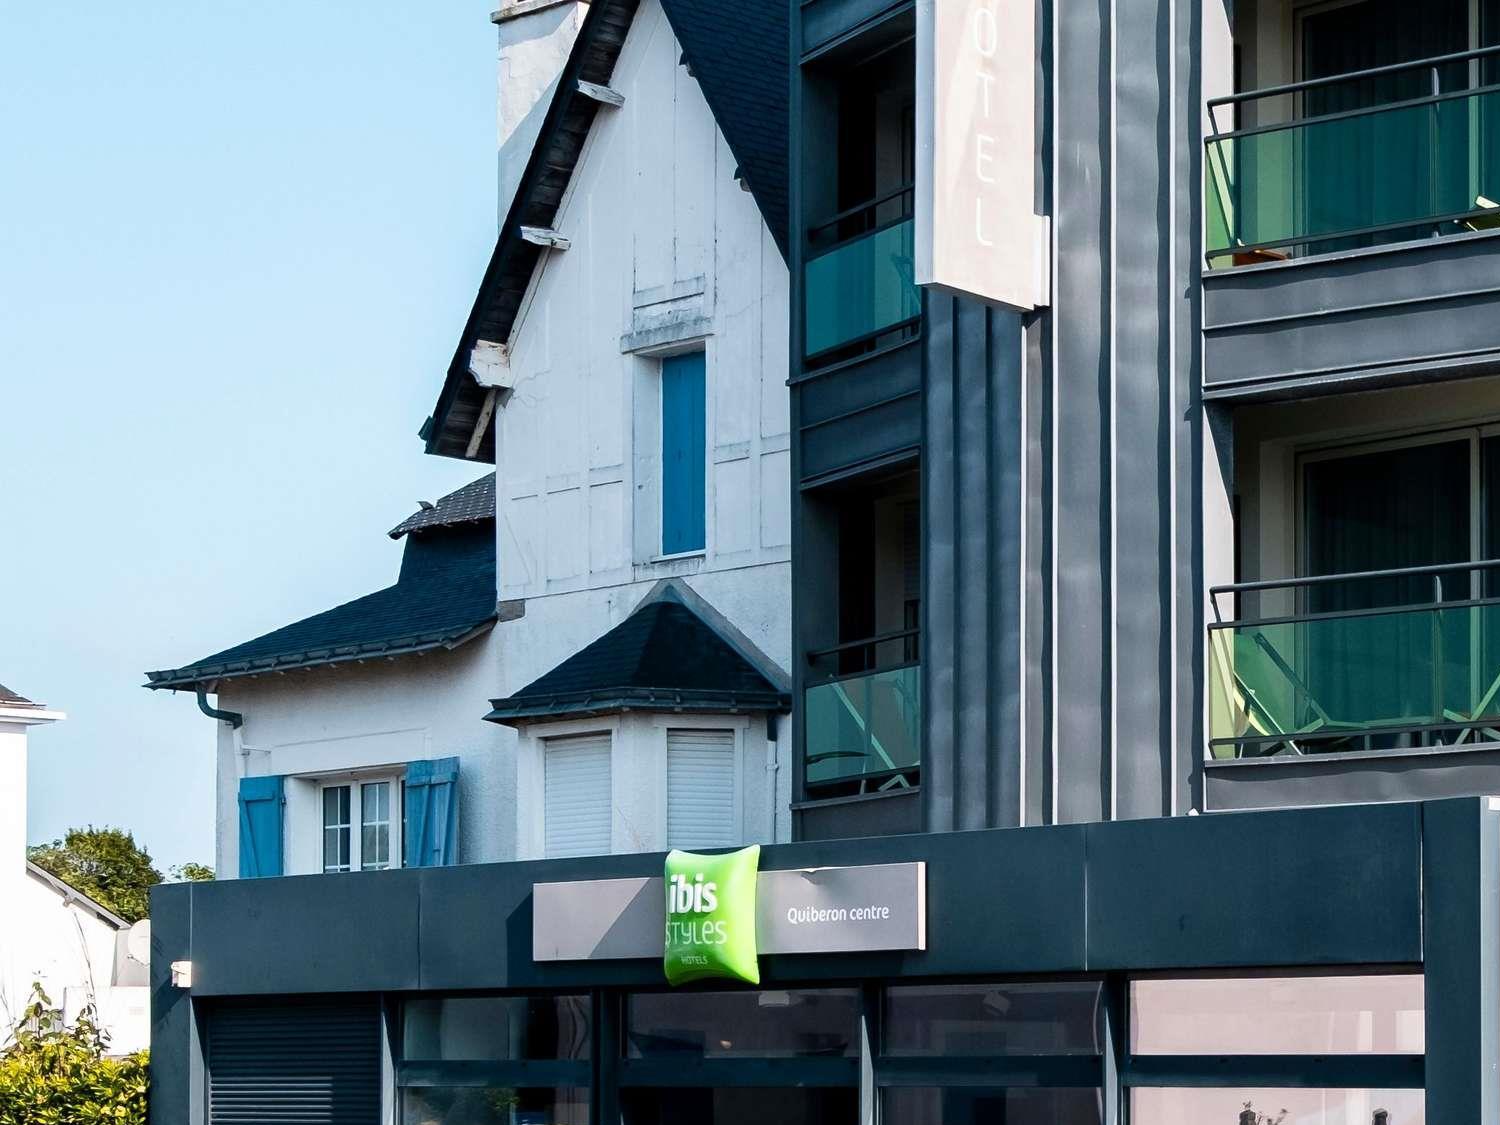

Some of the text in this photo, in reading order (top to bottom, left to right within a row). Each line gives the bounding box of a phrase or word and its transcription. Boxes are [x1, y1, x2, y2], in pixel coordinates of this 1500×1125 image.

[669, 873, 717, 913] ibis
[787, 904, 890, 925] Quiberon centre
[681, 956, 708, 965] HOTELS
